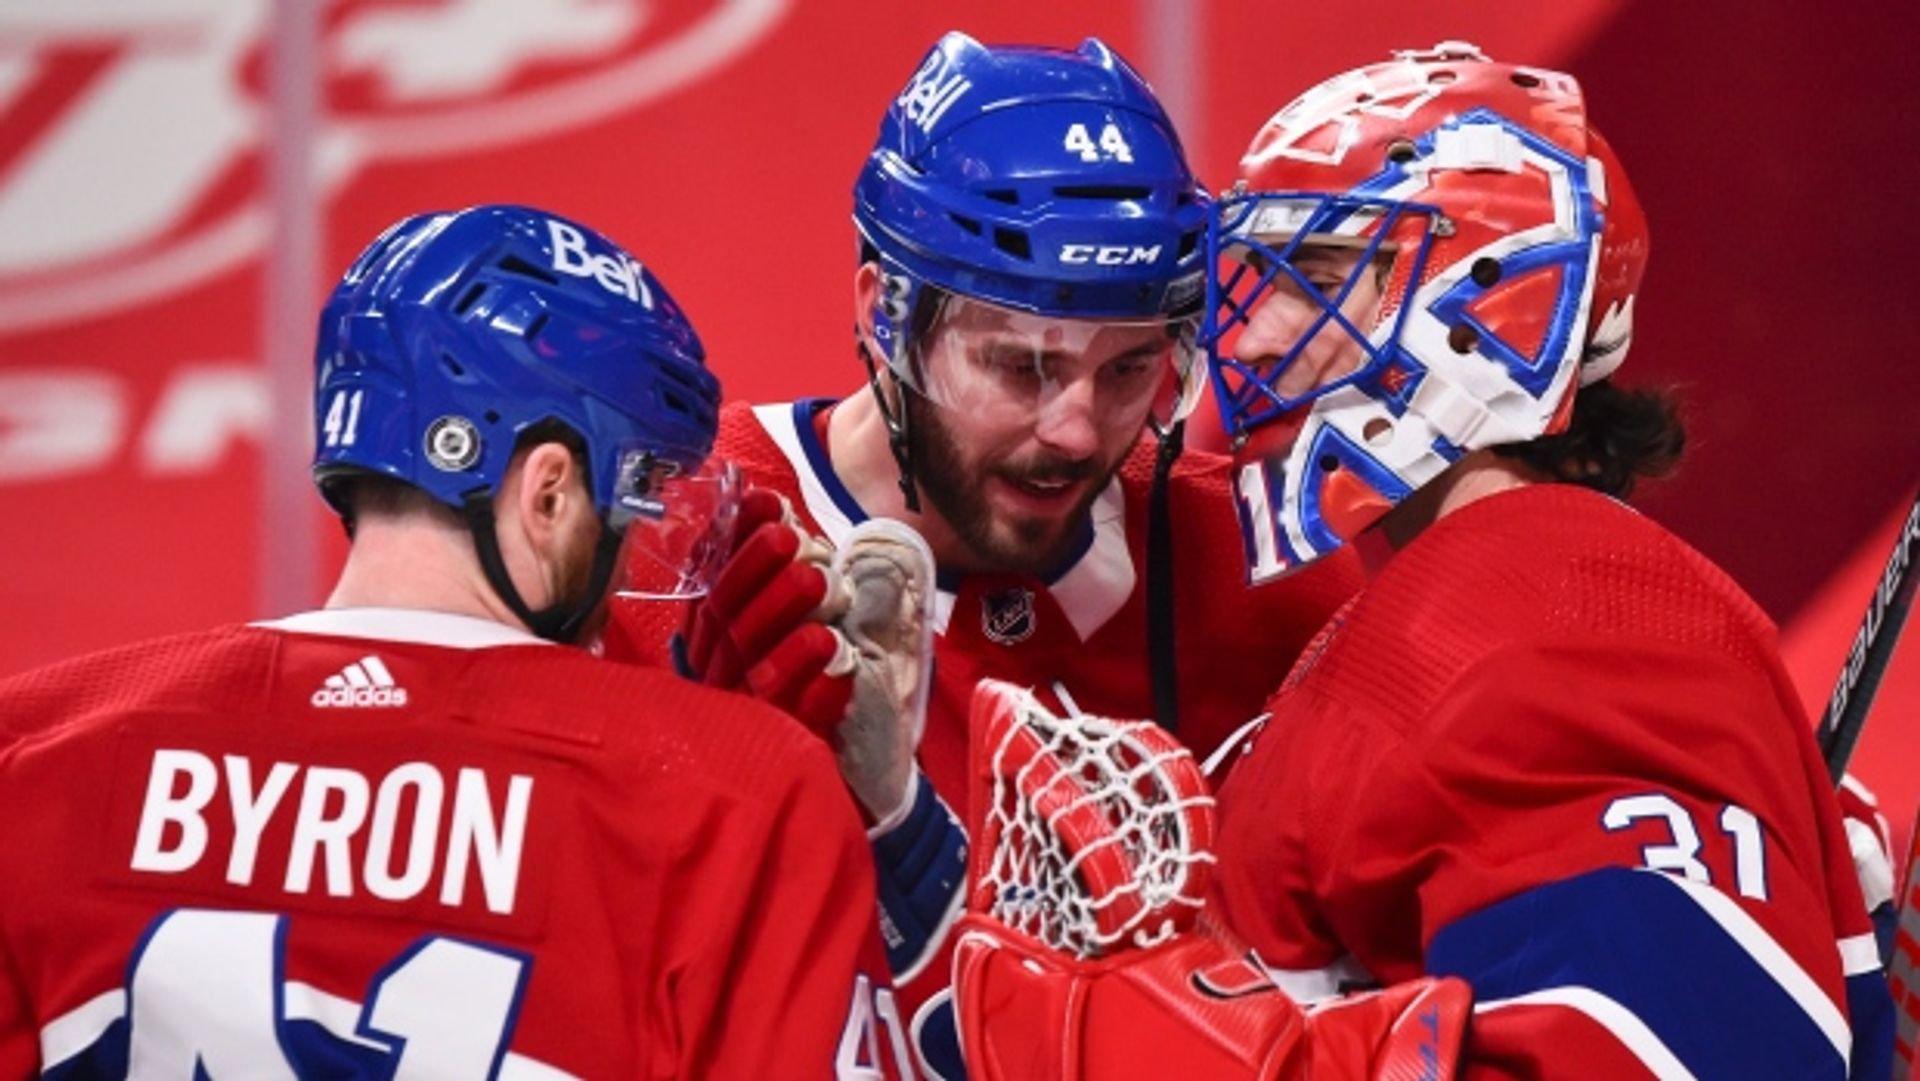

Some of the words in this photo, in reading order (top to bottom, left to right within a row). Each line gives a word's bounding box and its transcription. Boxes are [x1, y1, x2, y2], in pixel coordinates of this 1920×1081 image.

[896, 48, 973, 135] Bell
[1063, 123, 1135, 163] 44
[546, 219, 655, 312] Bell
[1058, 244, 1163, 266] CCM
[323, 390, 365, 447] 41
[309, 684, 409, 708] adidas
[129, 748, 535, 916] BYRON
[1600, 791, 1770, 903] 31
[124, 906, 535, 1081] 41
[834, 973, 917, 1081] 41
